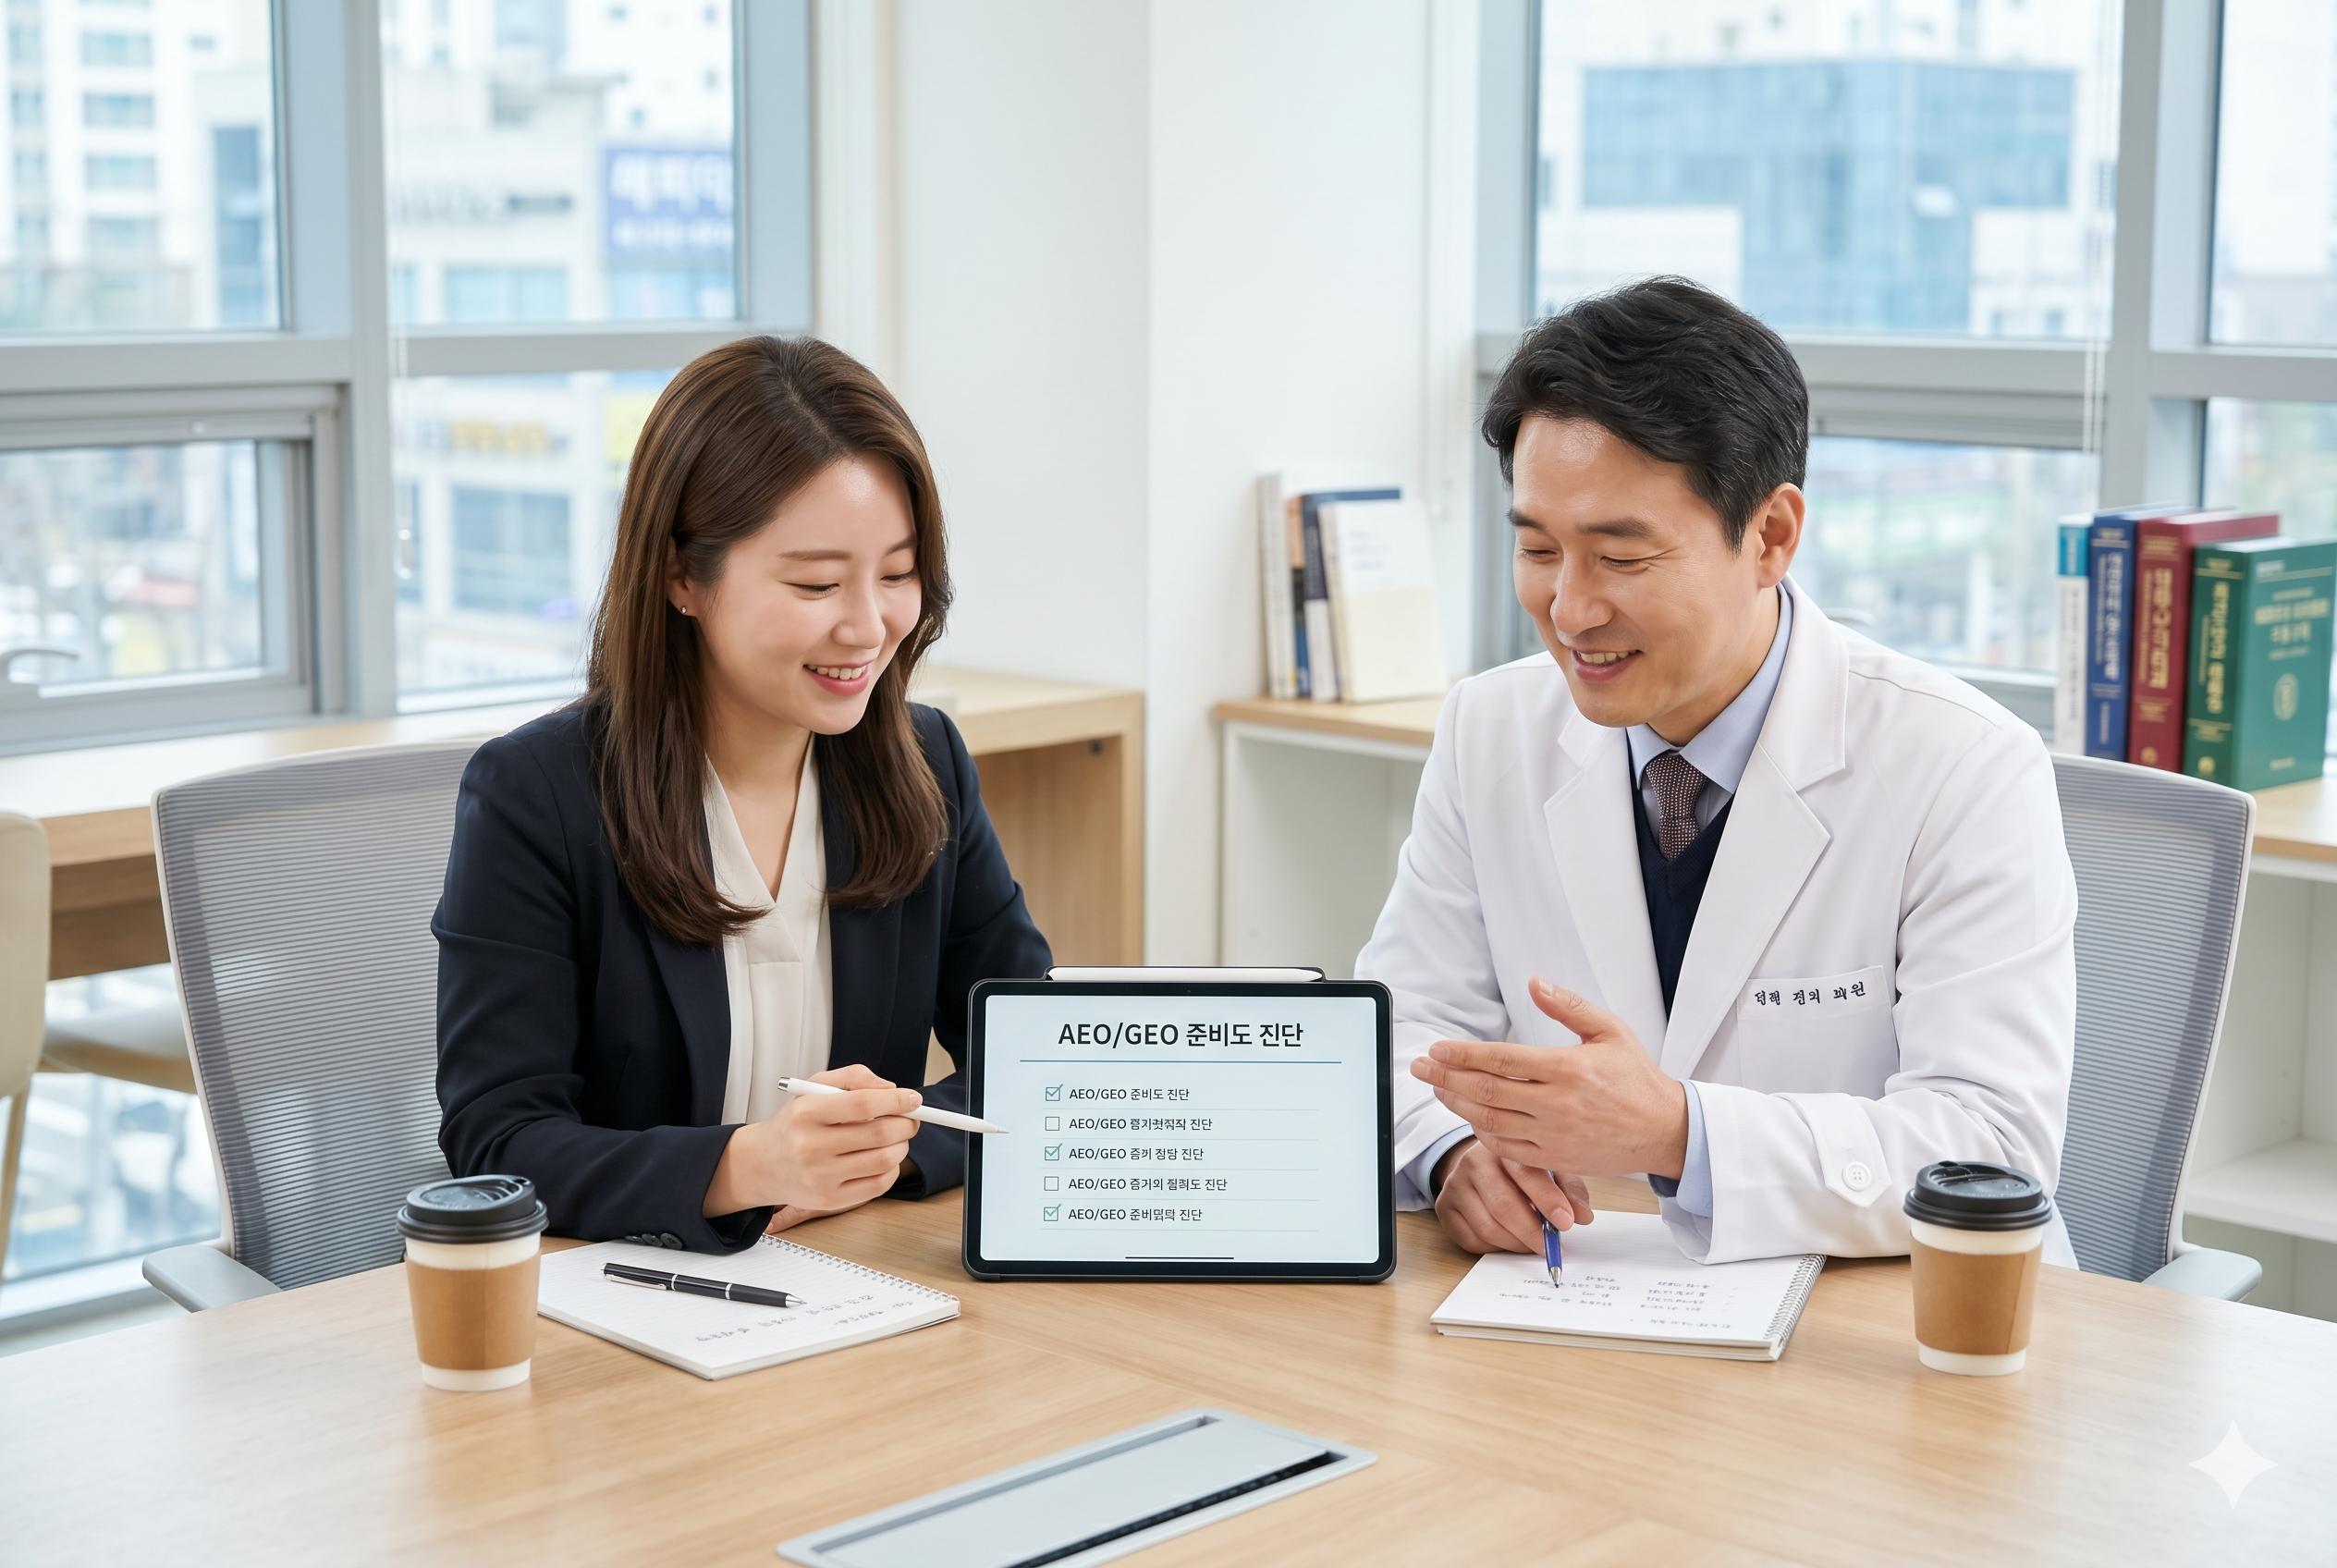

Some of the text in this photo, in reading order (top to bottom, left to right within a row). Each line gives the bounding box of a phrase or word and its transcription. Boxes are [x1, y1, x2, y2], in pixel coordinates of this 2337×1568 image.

[1058, 1022, 1304, 1048] AEO/GEO 준비도 진단
[1069, 1088, 1191, 1101] AEO/GEO 준비도 진단
[1069, 1118, 1127, 1131] AEO/GEO
[1190, 1118, 1214, 1131] 진단
[1069, 1147, 1127, 1161] AEO/GEO
[1181, 1147, 1205, 1161] 진단
[1068, 1178, 1127, 1191] AEO/GEO
[1205, 1178, 1229, 1192] 진단
[1068, 1208, 1127, 1221] AEO/GEO
[1179, 1208, 1204, 1222] 진단
